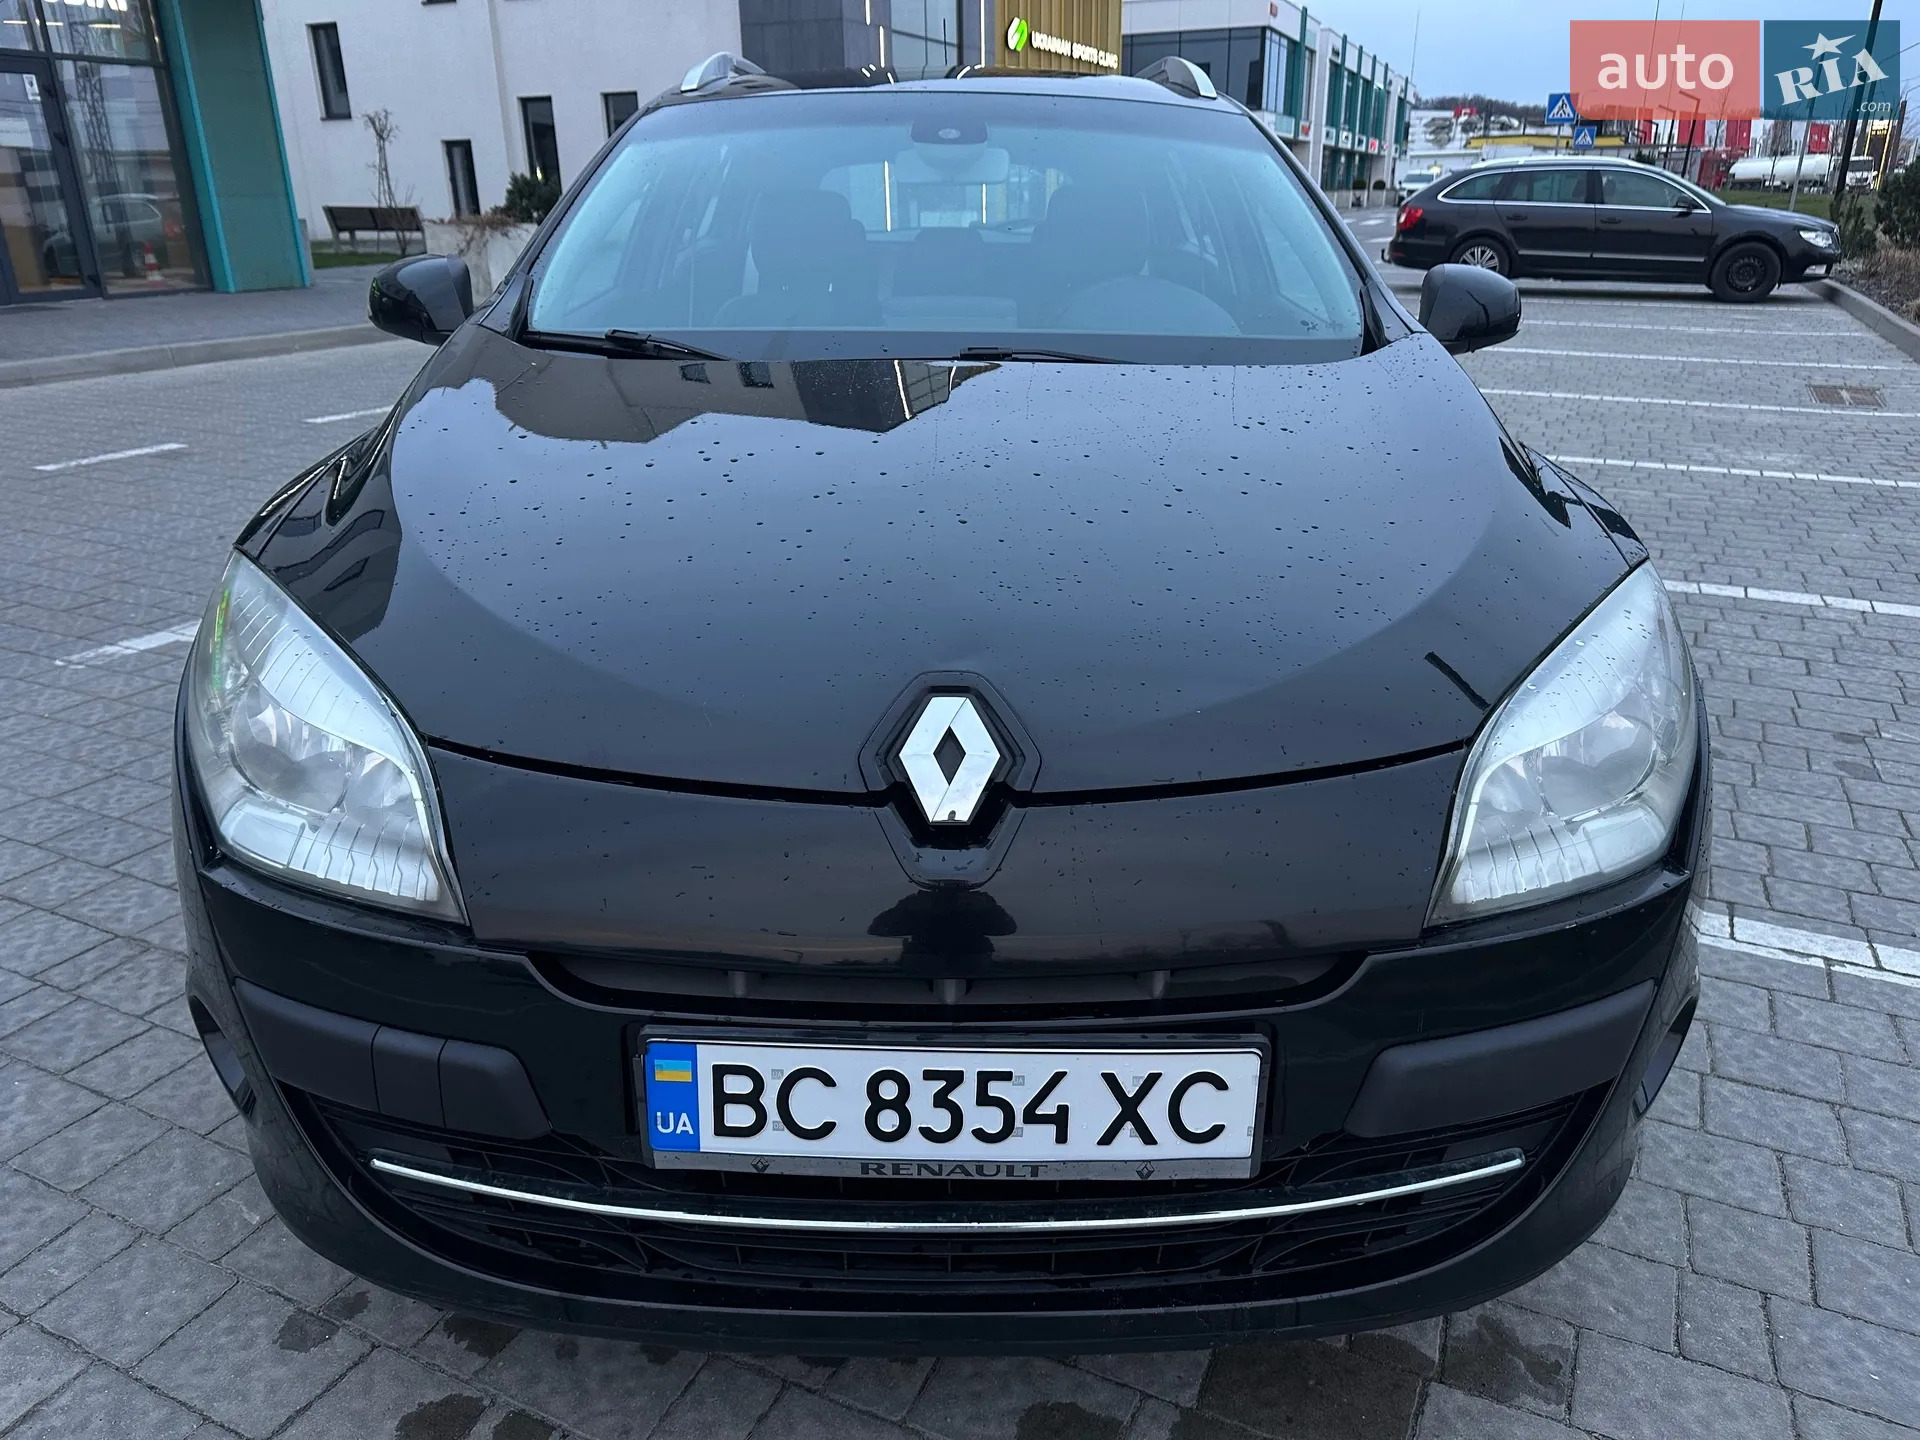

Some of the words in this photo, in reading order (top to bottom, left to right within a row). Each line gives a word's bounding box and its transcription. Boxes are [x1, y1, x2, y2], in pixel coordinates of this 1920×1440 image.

[1031, 30, 1071, 57] UKRAINIAN
[1072, 42, 1098, 64] SPORTS
[1098, 50, 1118, 69] CLINIC
[712, 1063, 837, 1141] BC
[864, 1069, 1070, 1144] 8354
[1097, 1071, 1229, 1146] XC
[656, 1112, 694, 1135] UA
[860, 1162, 1048, 1178] RENAULT
